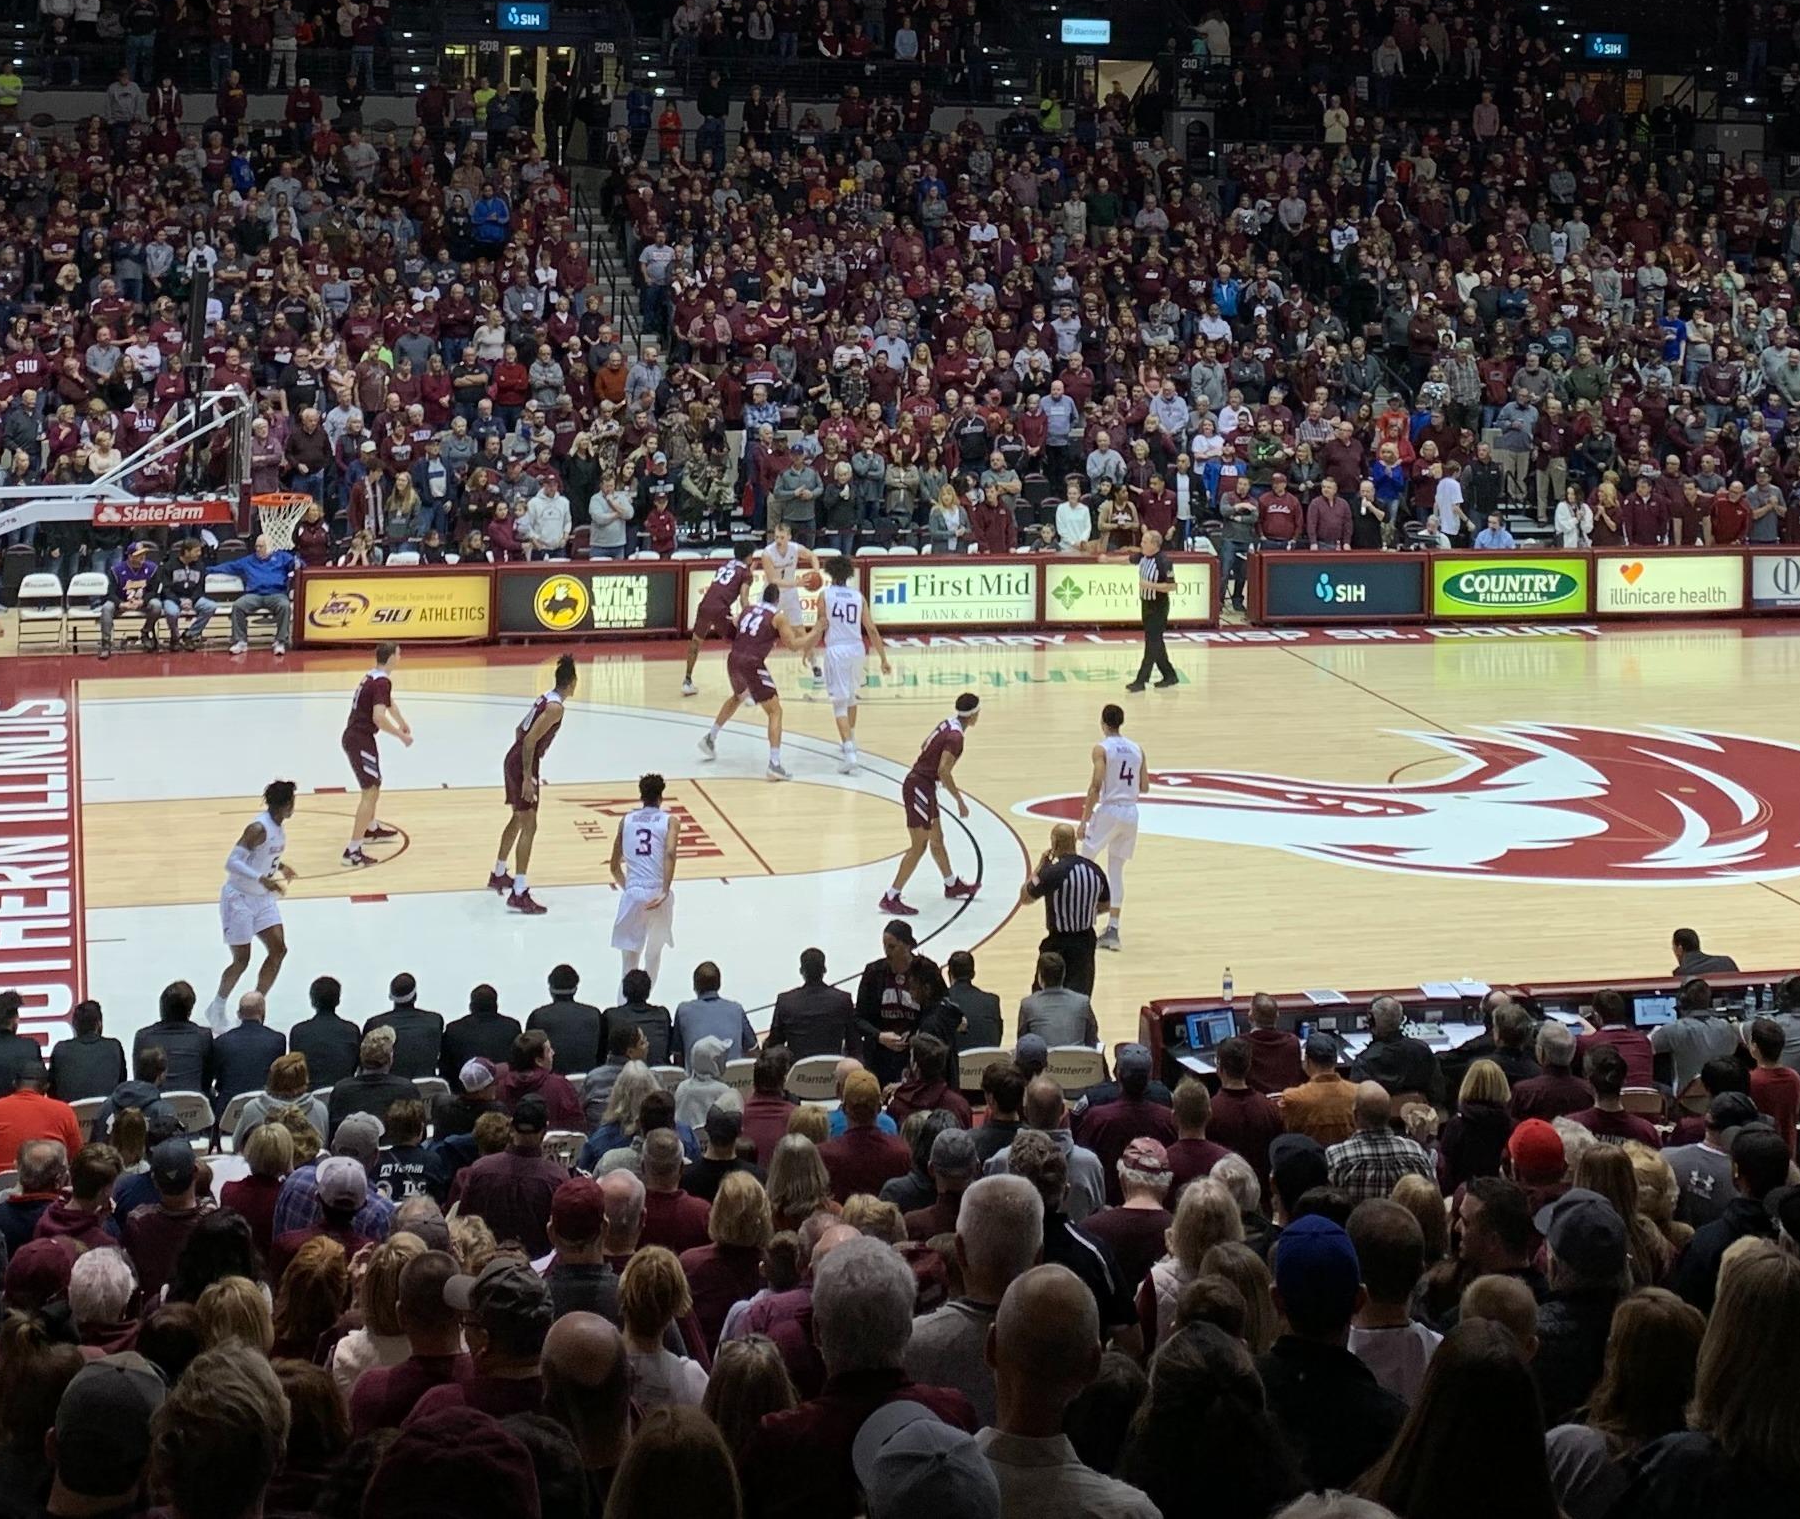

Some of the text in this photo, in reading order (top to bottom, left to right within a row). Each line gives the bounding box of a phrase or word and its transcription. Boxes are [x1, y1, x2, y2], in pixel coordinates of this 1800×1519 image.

[520, 15, 539, 25] SIH
[1604, 45, 1621, 54] SIH
[16, 360, 37, 373] SIU
[592, 575, 648, 588] BUFFALO
[715, 566, 735, 584] 33
[1459, 573, 1561, 593] COUNTRY
[913, 572, 1030, 597] First Mid
[1089, 581, 1134, 596] FARM
[593, 588, 647, 605] WILD
[1335, 584, 1366, 603] SIH
[1479, 592, 1545, 603] FINANCIAL
[1610, 586, 1727, 605] illinicare health
[370, 608, 413, 624] SIU
[419, 607, 485, 622] ATHLETICS
[592, 605, 647, 621] WINGS
[832, 603, 857, 623] 40
[921, 607, 1022, 620] BANK & TRUST
[739, 612, 764, 636] 44
[883, 634, 1066, 648] HARRY
[1085, 634, 1129, 644] L.
[1323, 629, 1420, 640] SR.
[1424, 625, 1603, 639] COURT
[1119, 761, 1133, 786] 4
[635, 828, 652, 856] 3
